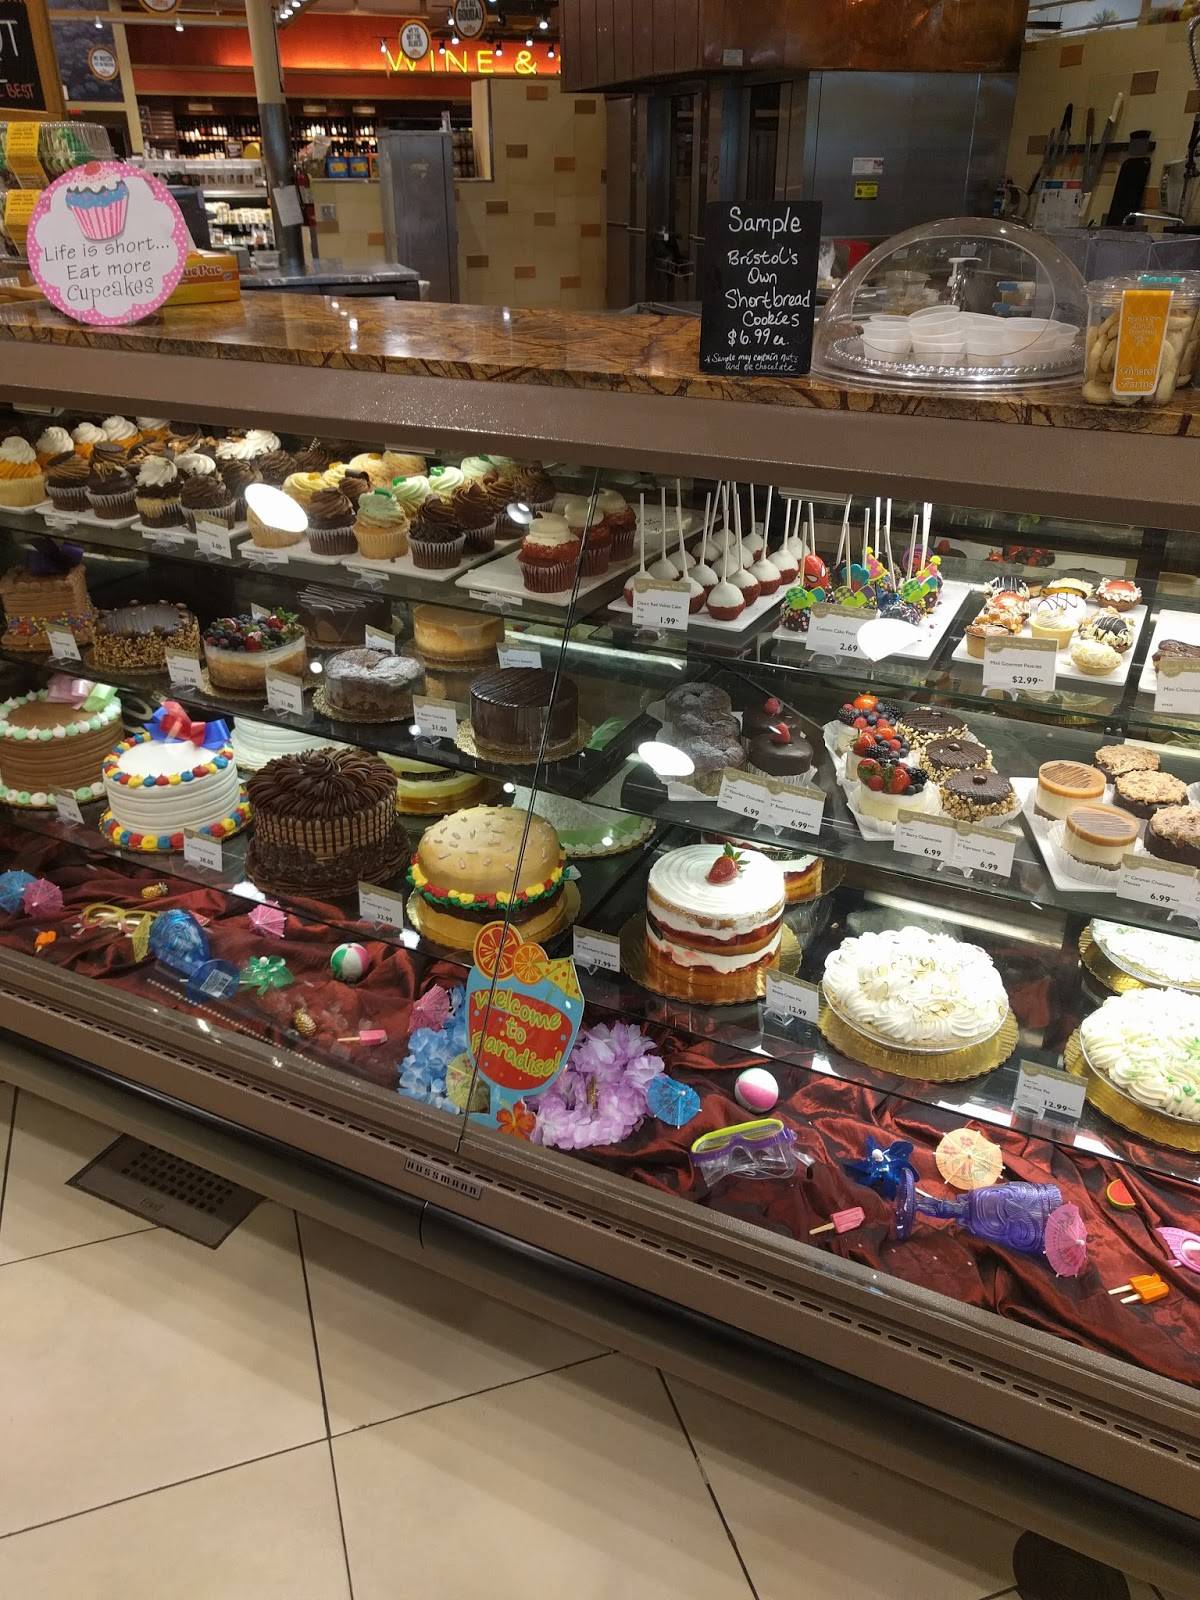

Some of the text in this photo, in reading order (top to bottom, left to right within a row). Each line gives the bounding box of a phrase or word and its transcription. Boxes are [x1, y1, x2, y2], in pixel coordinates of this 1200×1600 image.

[386, 50, 495, 74] WINE
[514, 50, 538, 75] &
[6, 83, 34, 99] BEST
[728, 206, 802, 240] Sample
[44, 238, 170, 262] Life is short...
[727, 246, 799, 266] Bristol's
[67, 259, 151, 280] Eat more
[747, 267, 778, 285] Own
[66, 275, 154, 308] Cupcakes
[725, 285, 811, 309] Shortbread
[742, 309, 800, 327] Cookies
[727, 327, 790, 348] $6.99 ea.
[755, 361, 796, 371] chocolate
[660, 616, 676, 625] 1.99
[840, 642, 858, 652] 2.69
[1012, 675, 1038, 685] $2.99
[743, 806, 760, 816] 6.99
[790, 820, 808, 829] 6.99
[924, 848, 942, 857] 6.99
[980, 861, 999, 871] 6.99
[1150, 893, 1171, 903] 6.99
[475, 988, 562, 1031] Welcome
[788, 1005, 807, 1016] 12.99
[505, 1016, 527, 1045] to
[471, 1031, 563, 1077] Paradise!
[1044, 1099, 1067, 1111] 12.99
